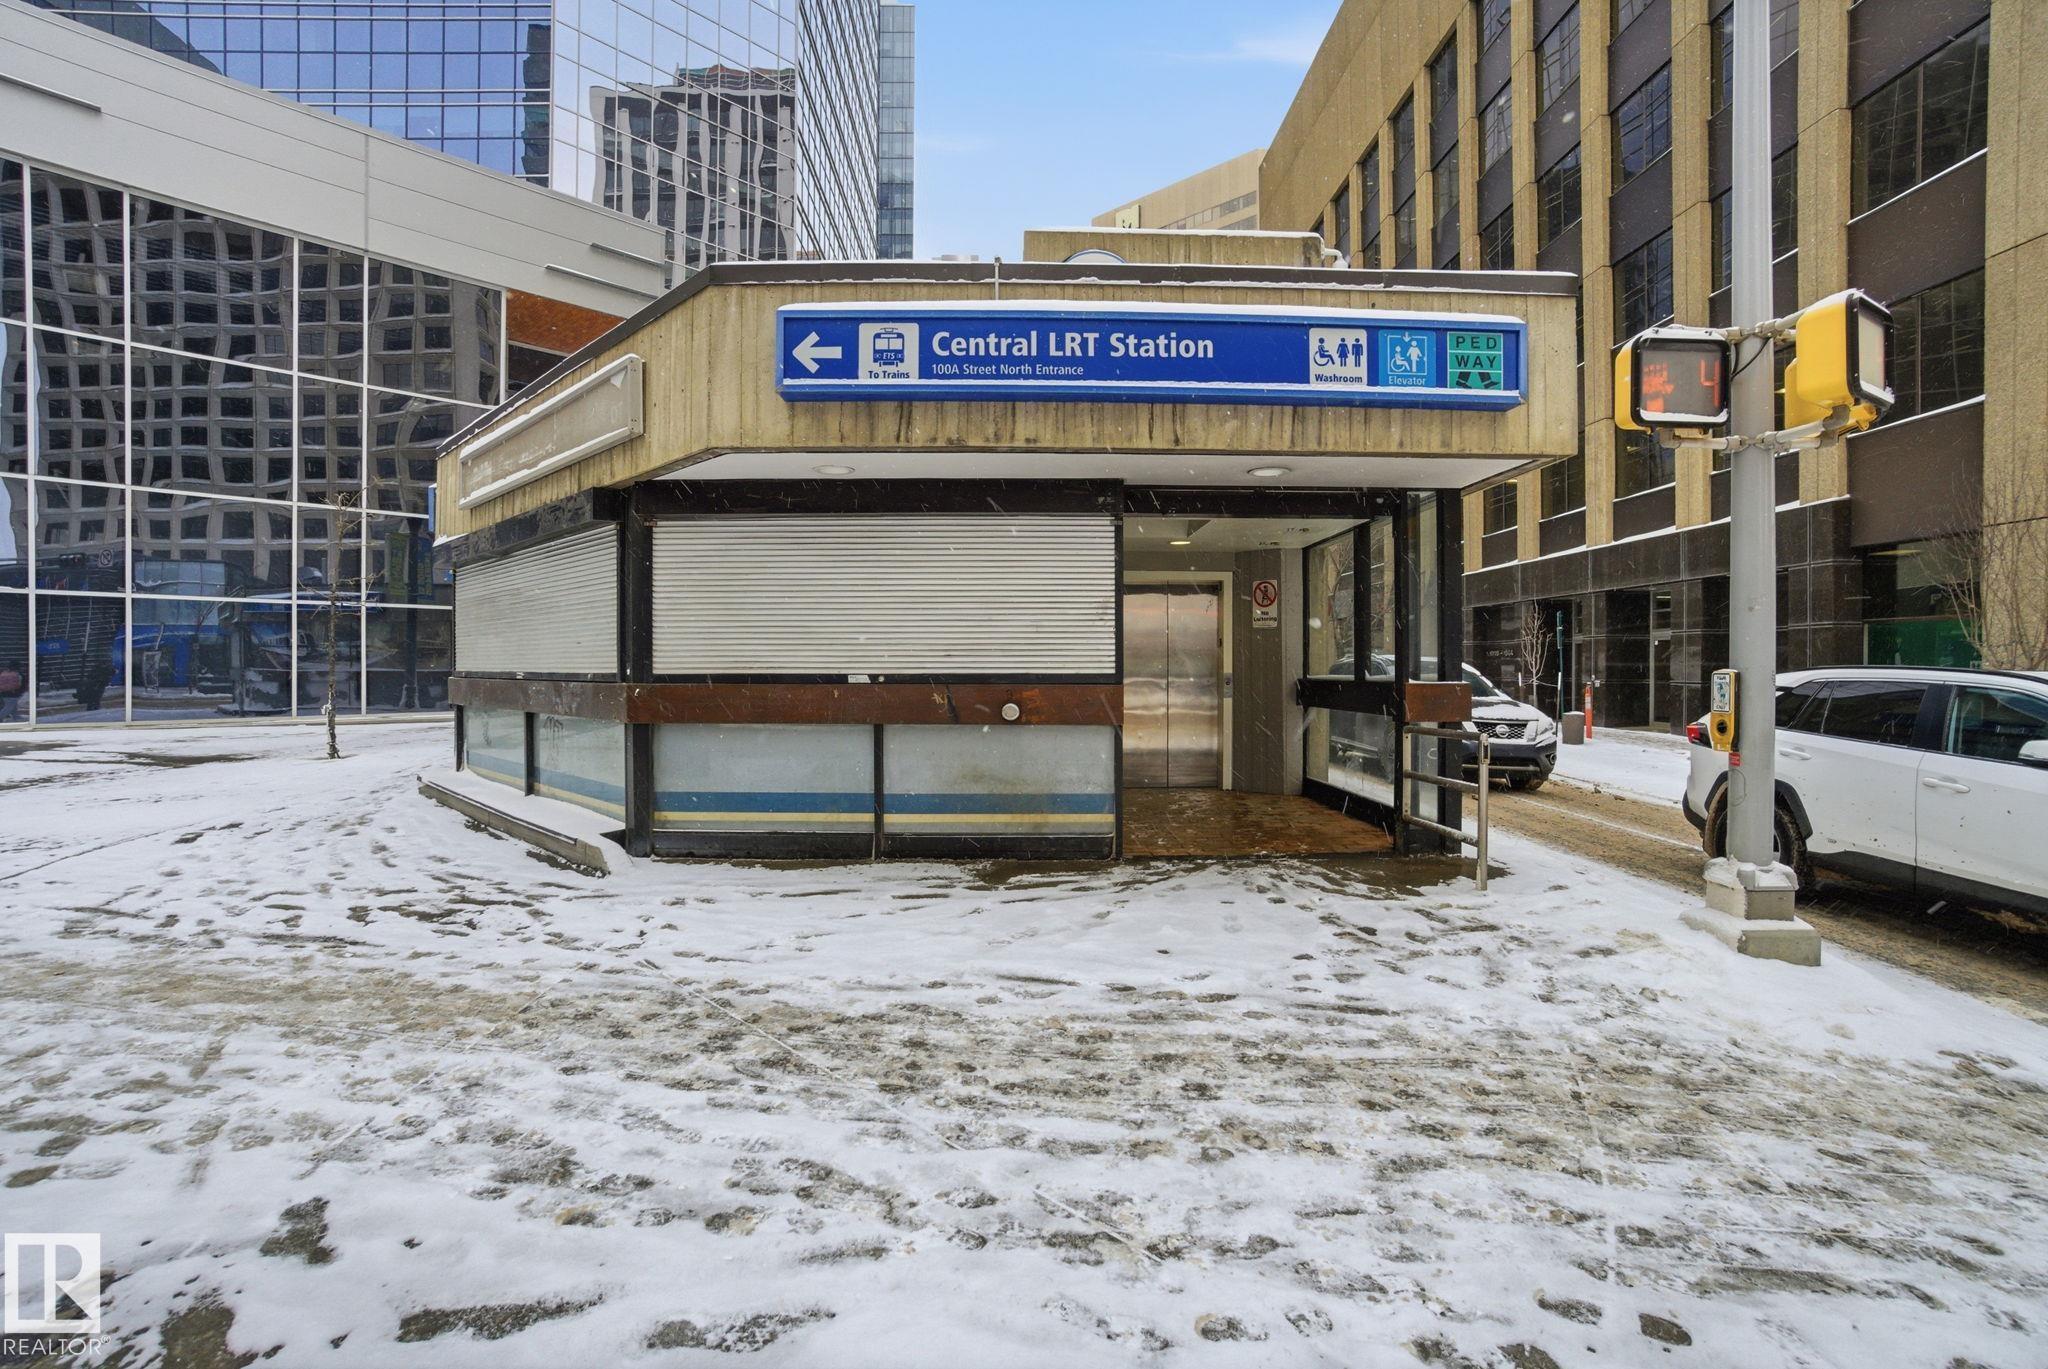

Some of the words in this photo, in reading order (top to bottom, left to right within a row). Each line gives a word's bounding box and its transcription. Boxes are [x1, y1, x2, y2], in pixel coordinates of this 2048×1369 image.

[931, 330, 1038, 357] Central
[1049, 331, 1100, 357] LRT
[1109, 331, 1215, 358] Station
[1455, 335, 1497, 350] PED
[882, 352, 895, 360] ETS
[1455, 354, 1497, 369] WAY
[868, 370, 879, 379] To
[882, 370, 910, 379] Trains
[931, 363, 960, 375] 100A
[963, 363, 997, 375] Street
[1000, 363, 1032, 375] North
[1036, 363, 1084, 376] Entrance
[1314, 373, 1363, 384] Washroom
[1388, 375, 1427, 386] Elevator
